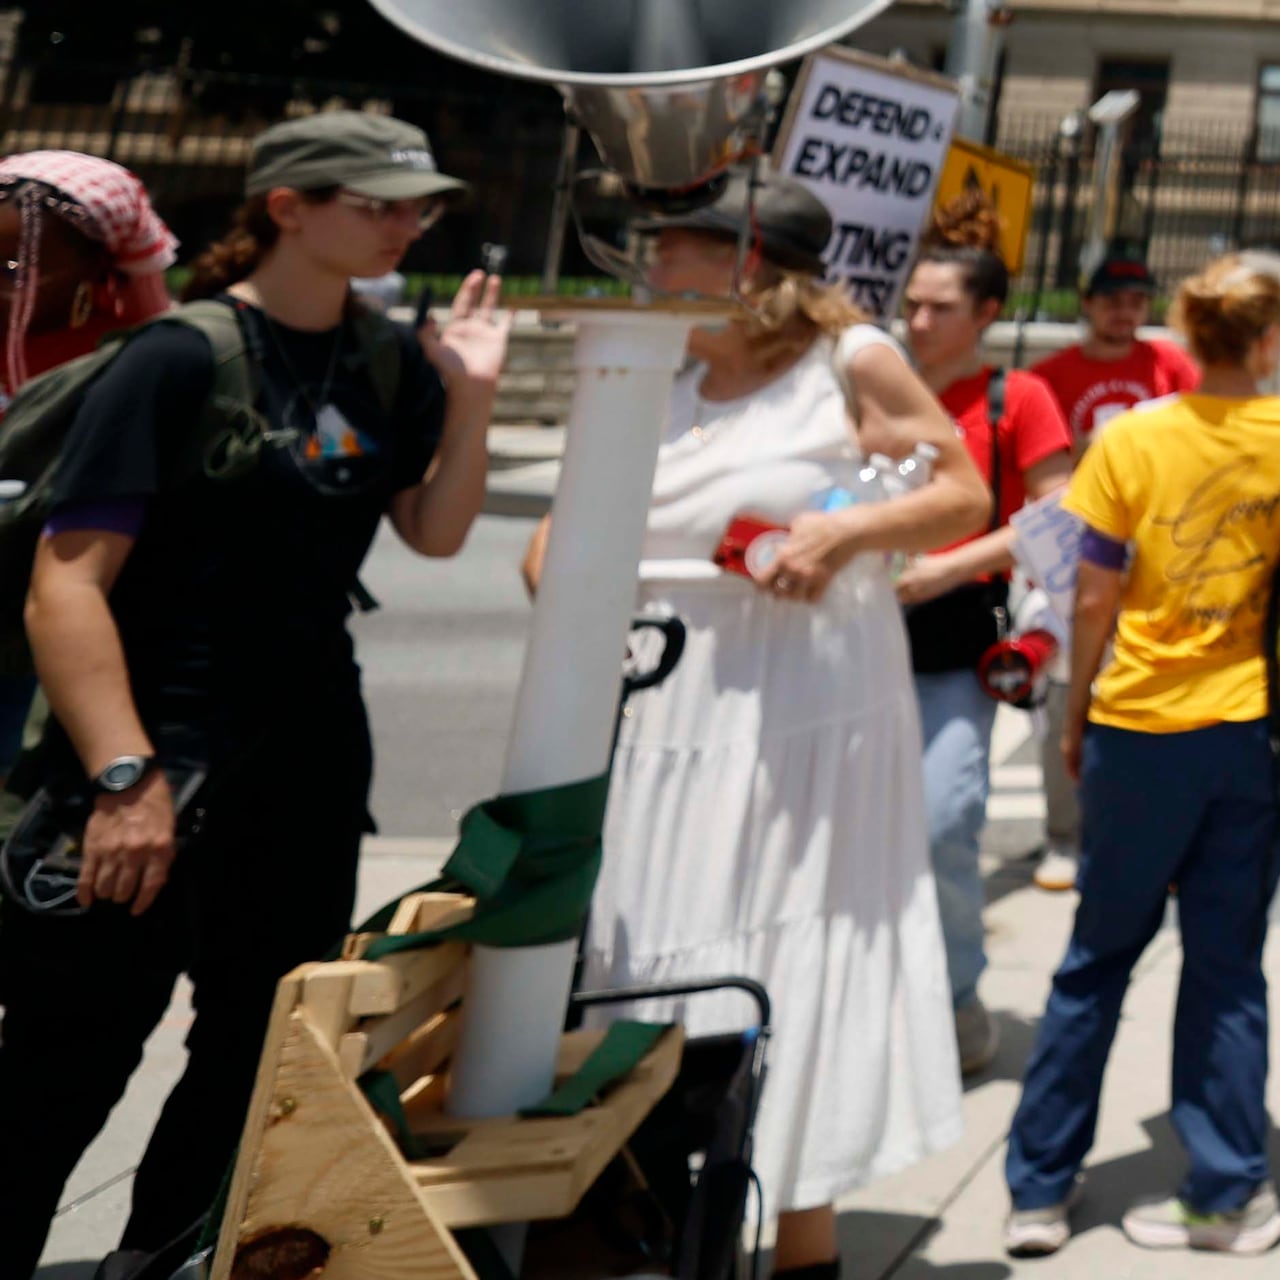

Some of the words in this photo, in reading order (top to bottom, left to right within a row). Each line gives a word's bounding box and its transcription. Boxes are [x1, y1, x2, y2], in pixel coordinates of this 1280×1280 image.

[813, 84, 930, 142] DEFEND
[794, 137, 932, 199] EXPAND
[832, 224, 909, 270] TING
